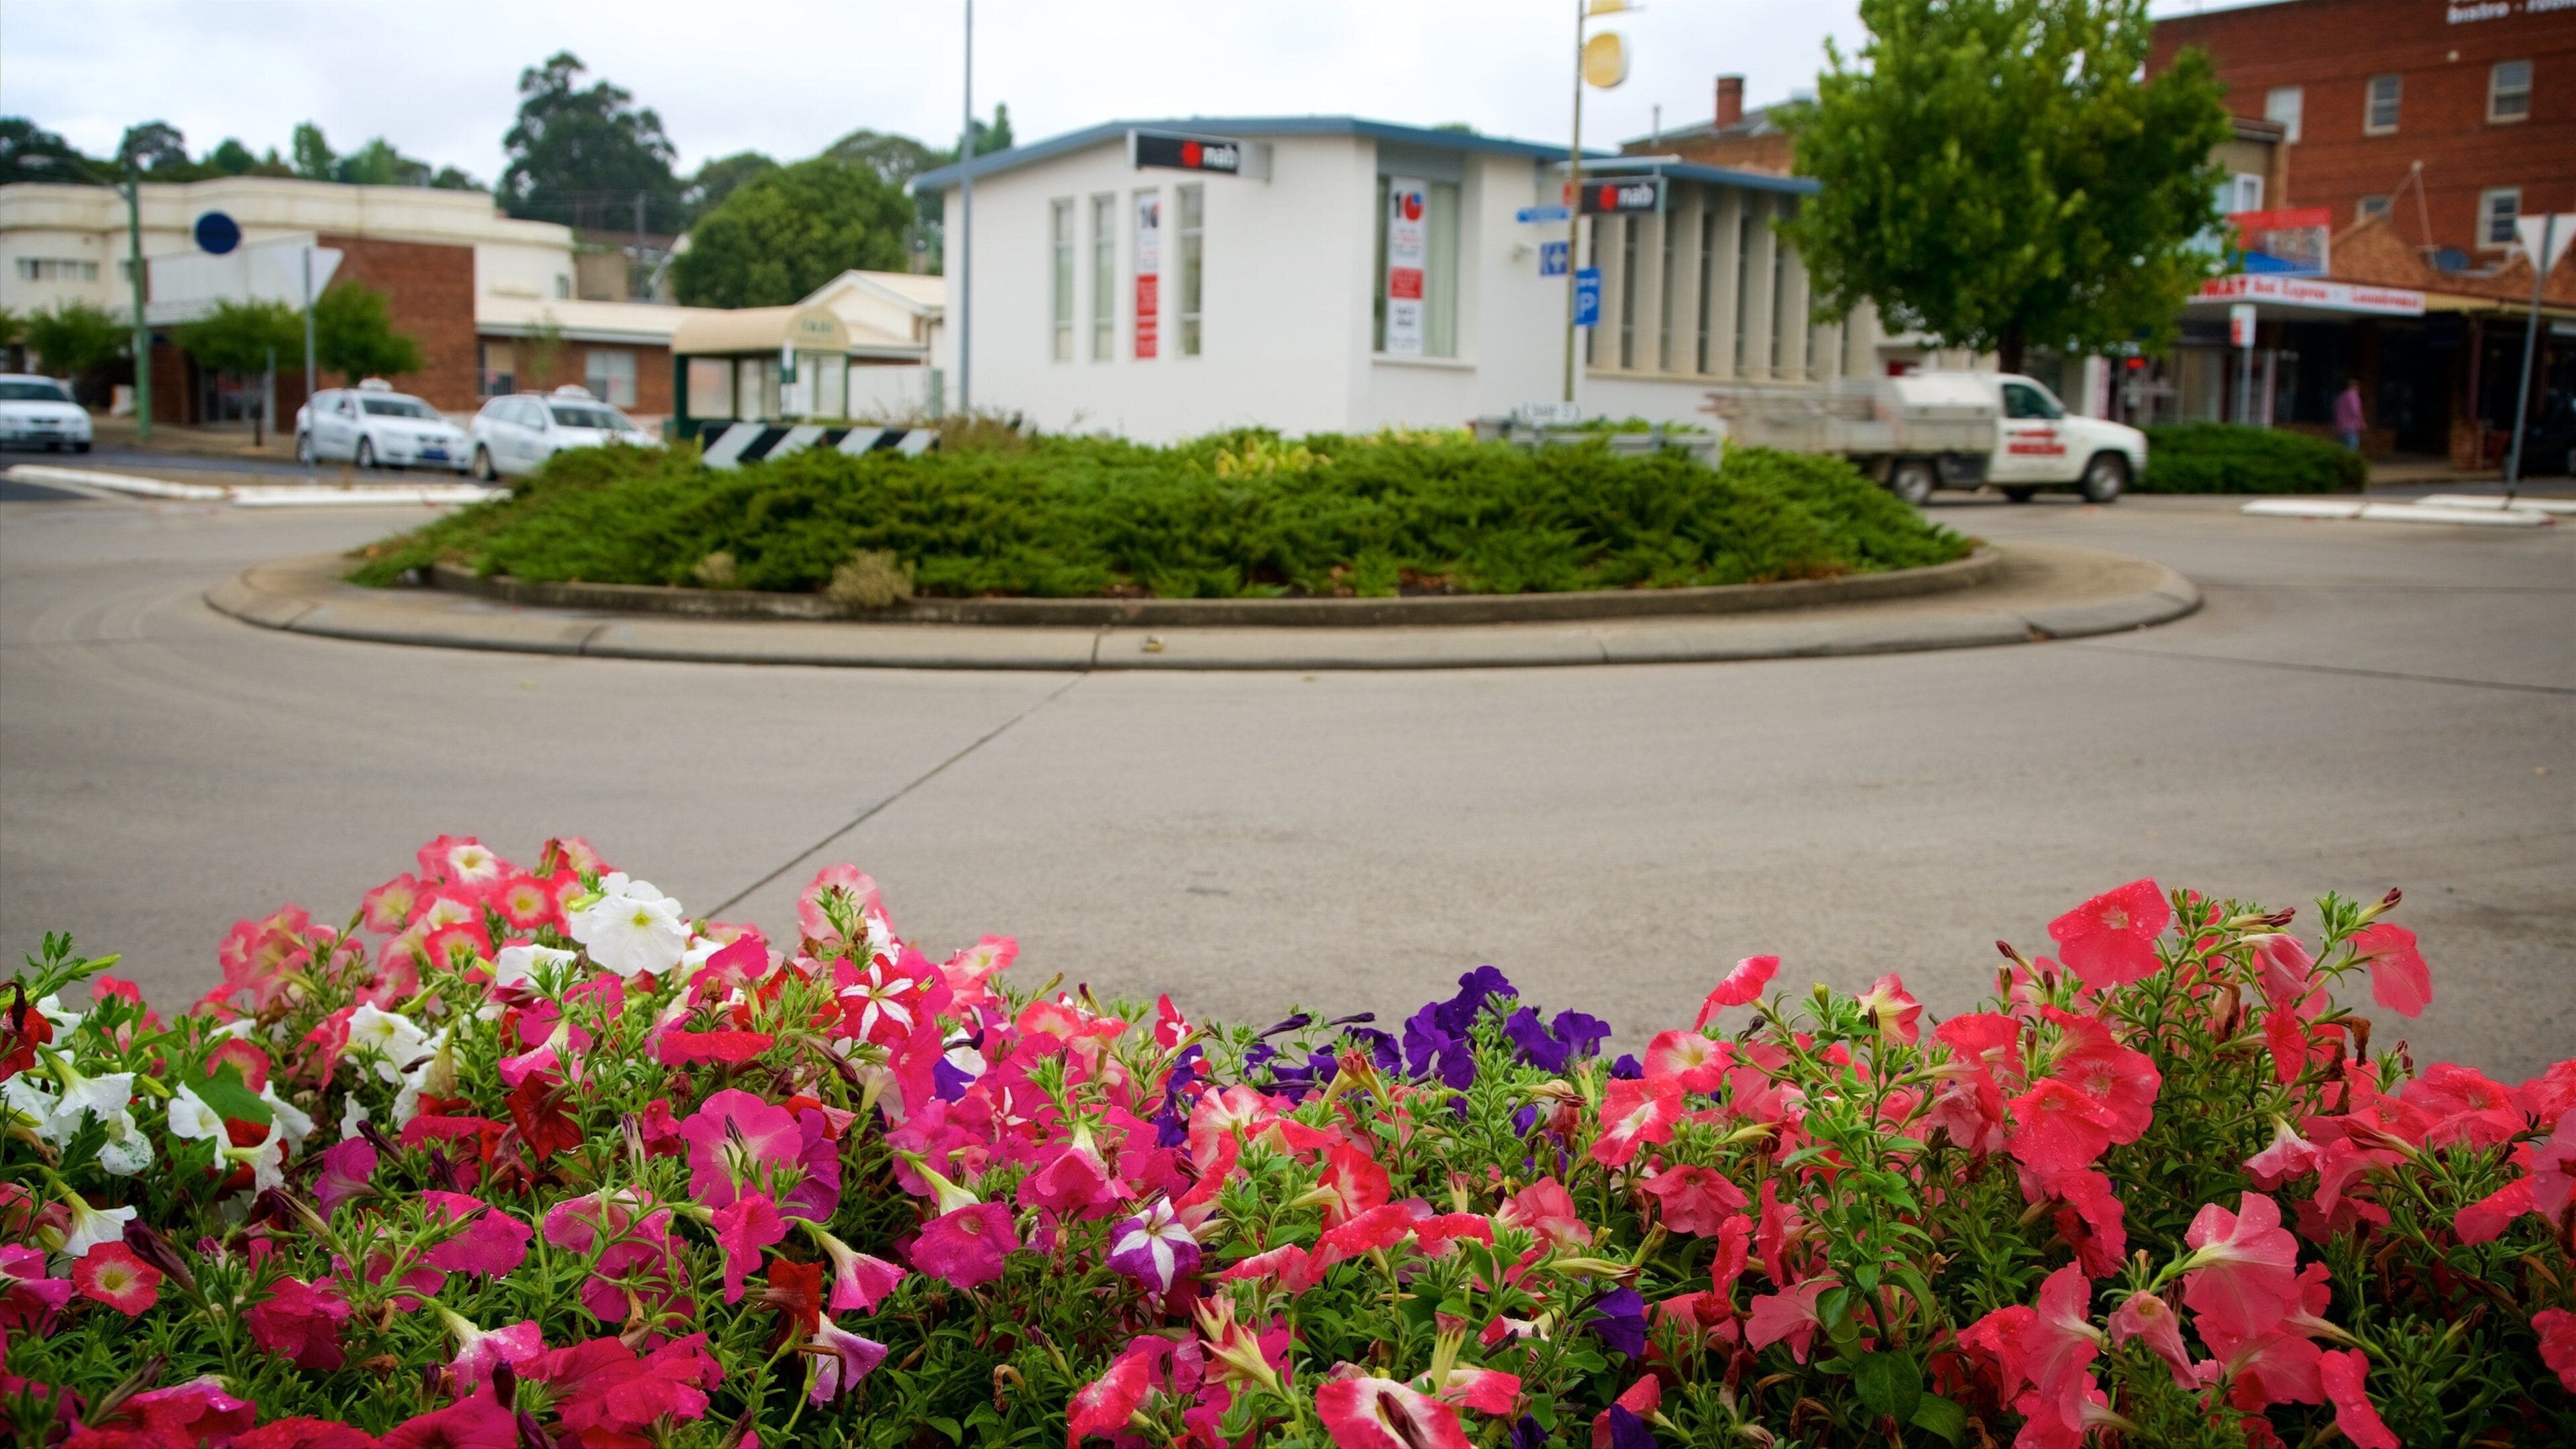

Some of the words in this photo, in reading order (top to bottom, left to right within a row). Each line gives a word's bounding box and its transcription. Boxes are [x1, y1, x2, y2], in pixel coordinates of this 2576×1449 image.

[2447, 2, 2509, 24] bistro
[1203, 144, 1239, 168] nab
[1618, 182, 1654, 207] nab
[1578, 291, 1597, 320] P
